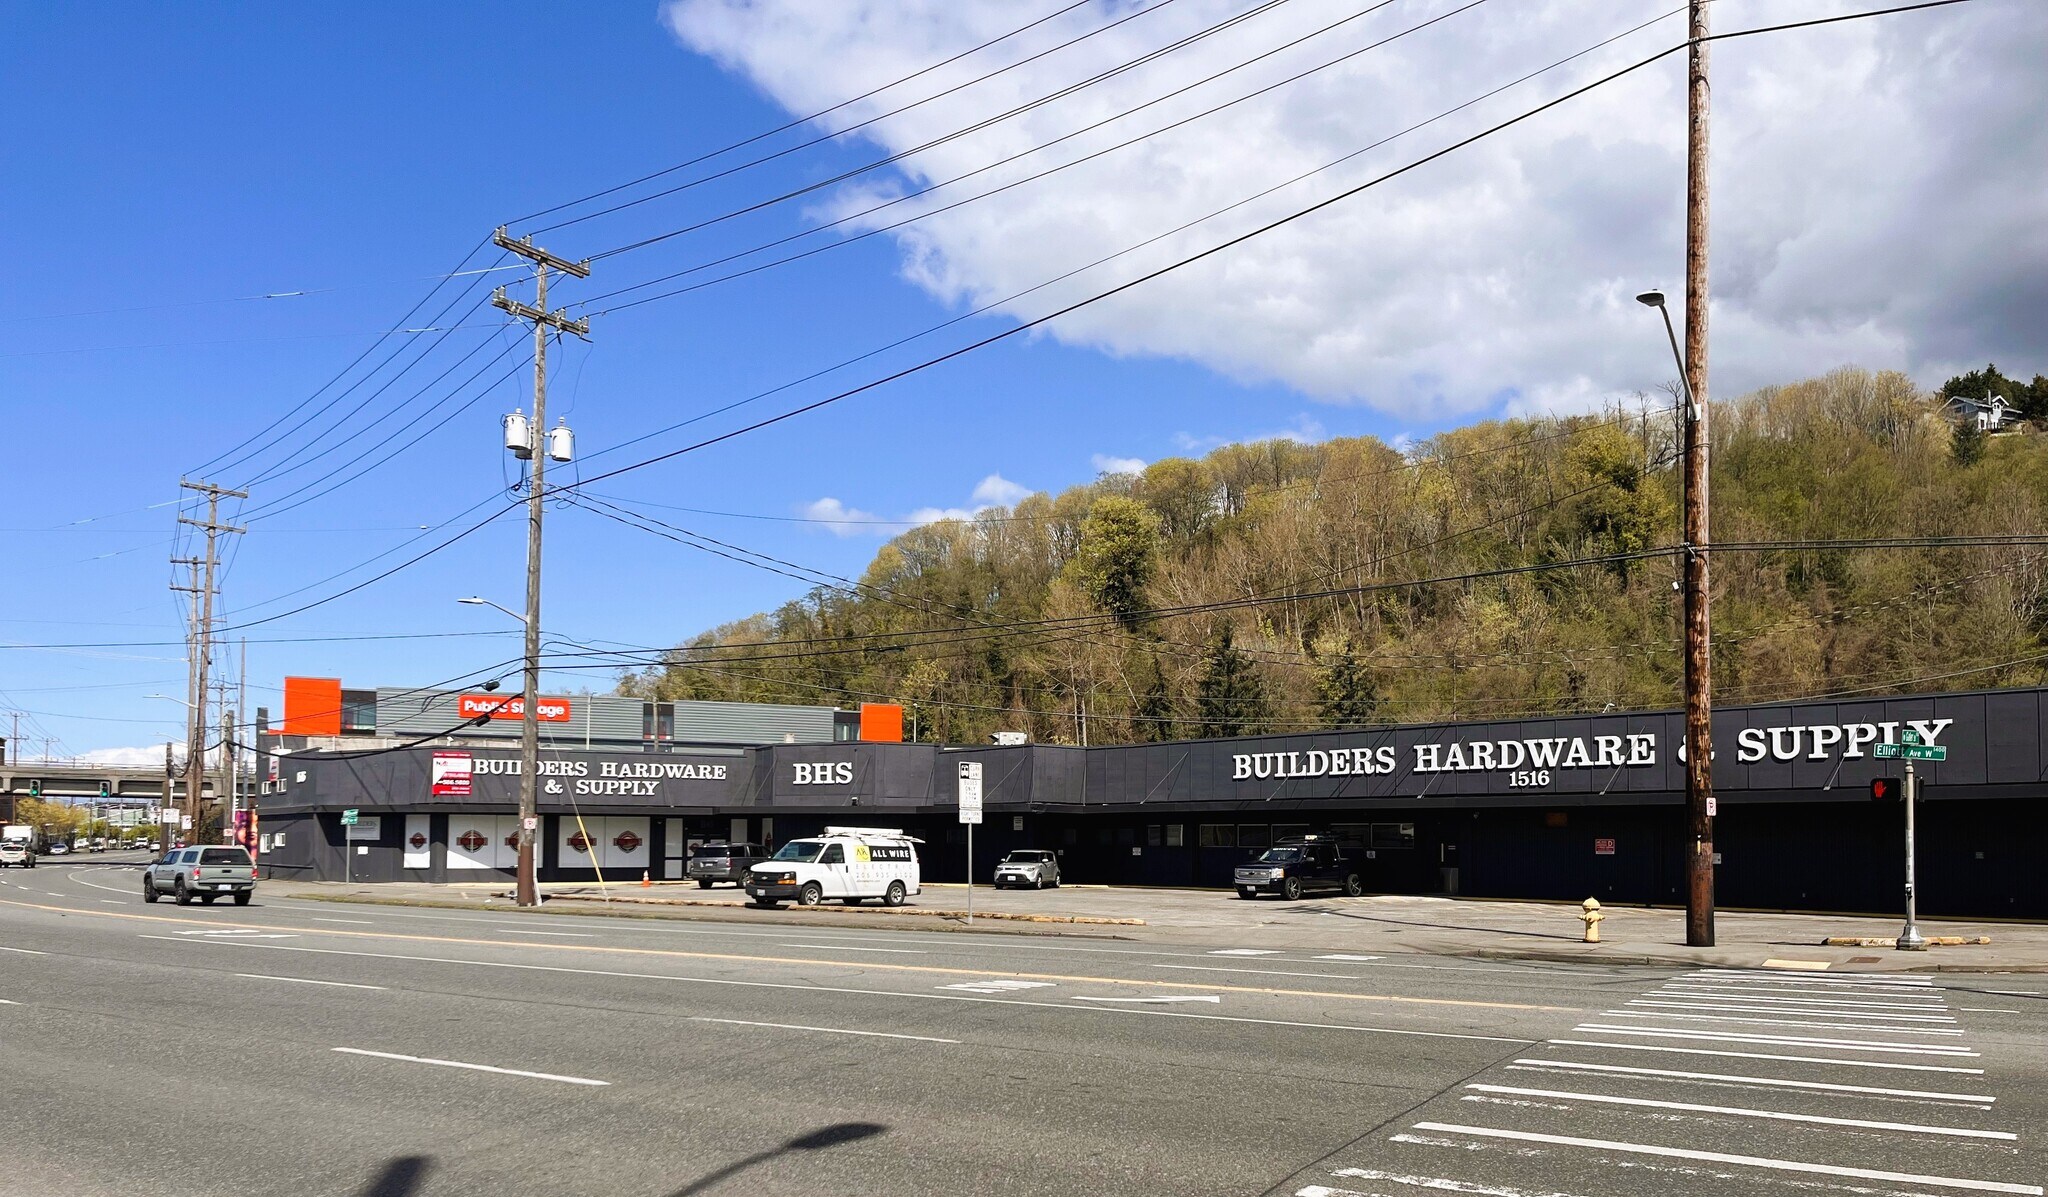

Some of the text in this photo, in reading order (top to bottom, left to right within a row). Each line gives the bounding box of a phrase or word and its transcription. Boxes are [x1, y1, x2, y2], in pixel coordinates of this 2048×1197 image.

[464, 700, 565, 718] Public Stage
[1233, 746, 1396, 779] BUILDERS
[1413, 734, 1656, 772] HARDWARE
[1738, 718, 1953, 762] SUPPLY
[1876, 745, 1905, 757] Elliott
[1909, 749, 1921, 757] Ave
[1925, 750, 1932, 758] W
[600, 762, 727, 780] HARDWARE
[793, 762, 853, 785] BHS
[1509, 770, 1550, 787] 1516
[544, 779, 660, 795] & SUPPLY
[872, 849, 887, 858] ALL
[889, 849, 909, 858] WIRE
